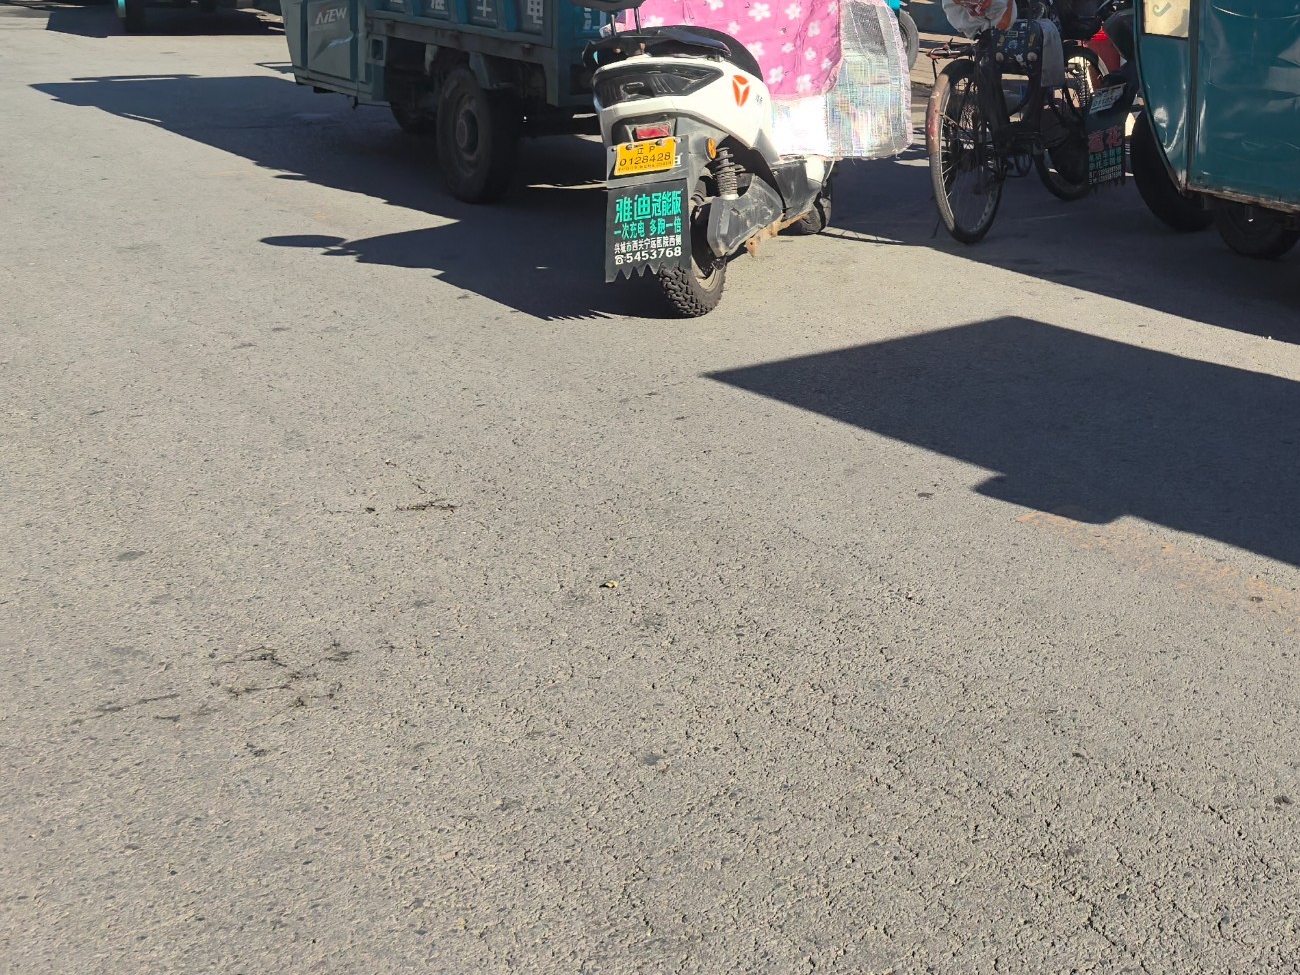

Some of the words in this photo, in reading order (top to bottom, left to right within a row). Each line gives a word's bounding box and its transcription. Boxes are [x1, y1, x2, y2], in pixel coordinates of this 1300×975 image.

[619, 152, 671, 167] 0128428
[614, 190, 682, 224] 雅迪冠能版
[613, 221, 646, 240] 一次充电
[649, 216, 682, 236] 多跑一倍
[626, 246, 682, 263] 5453768
